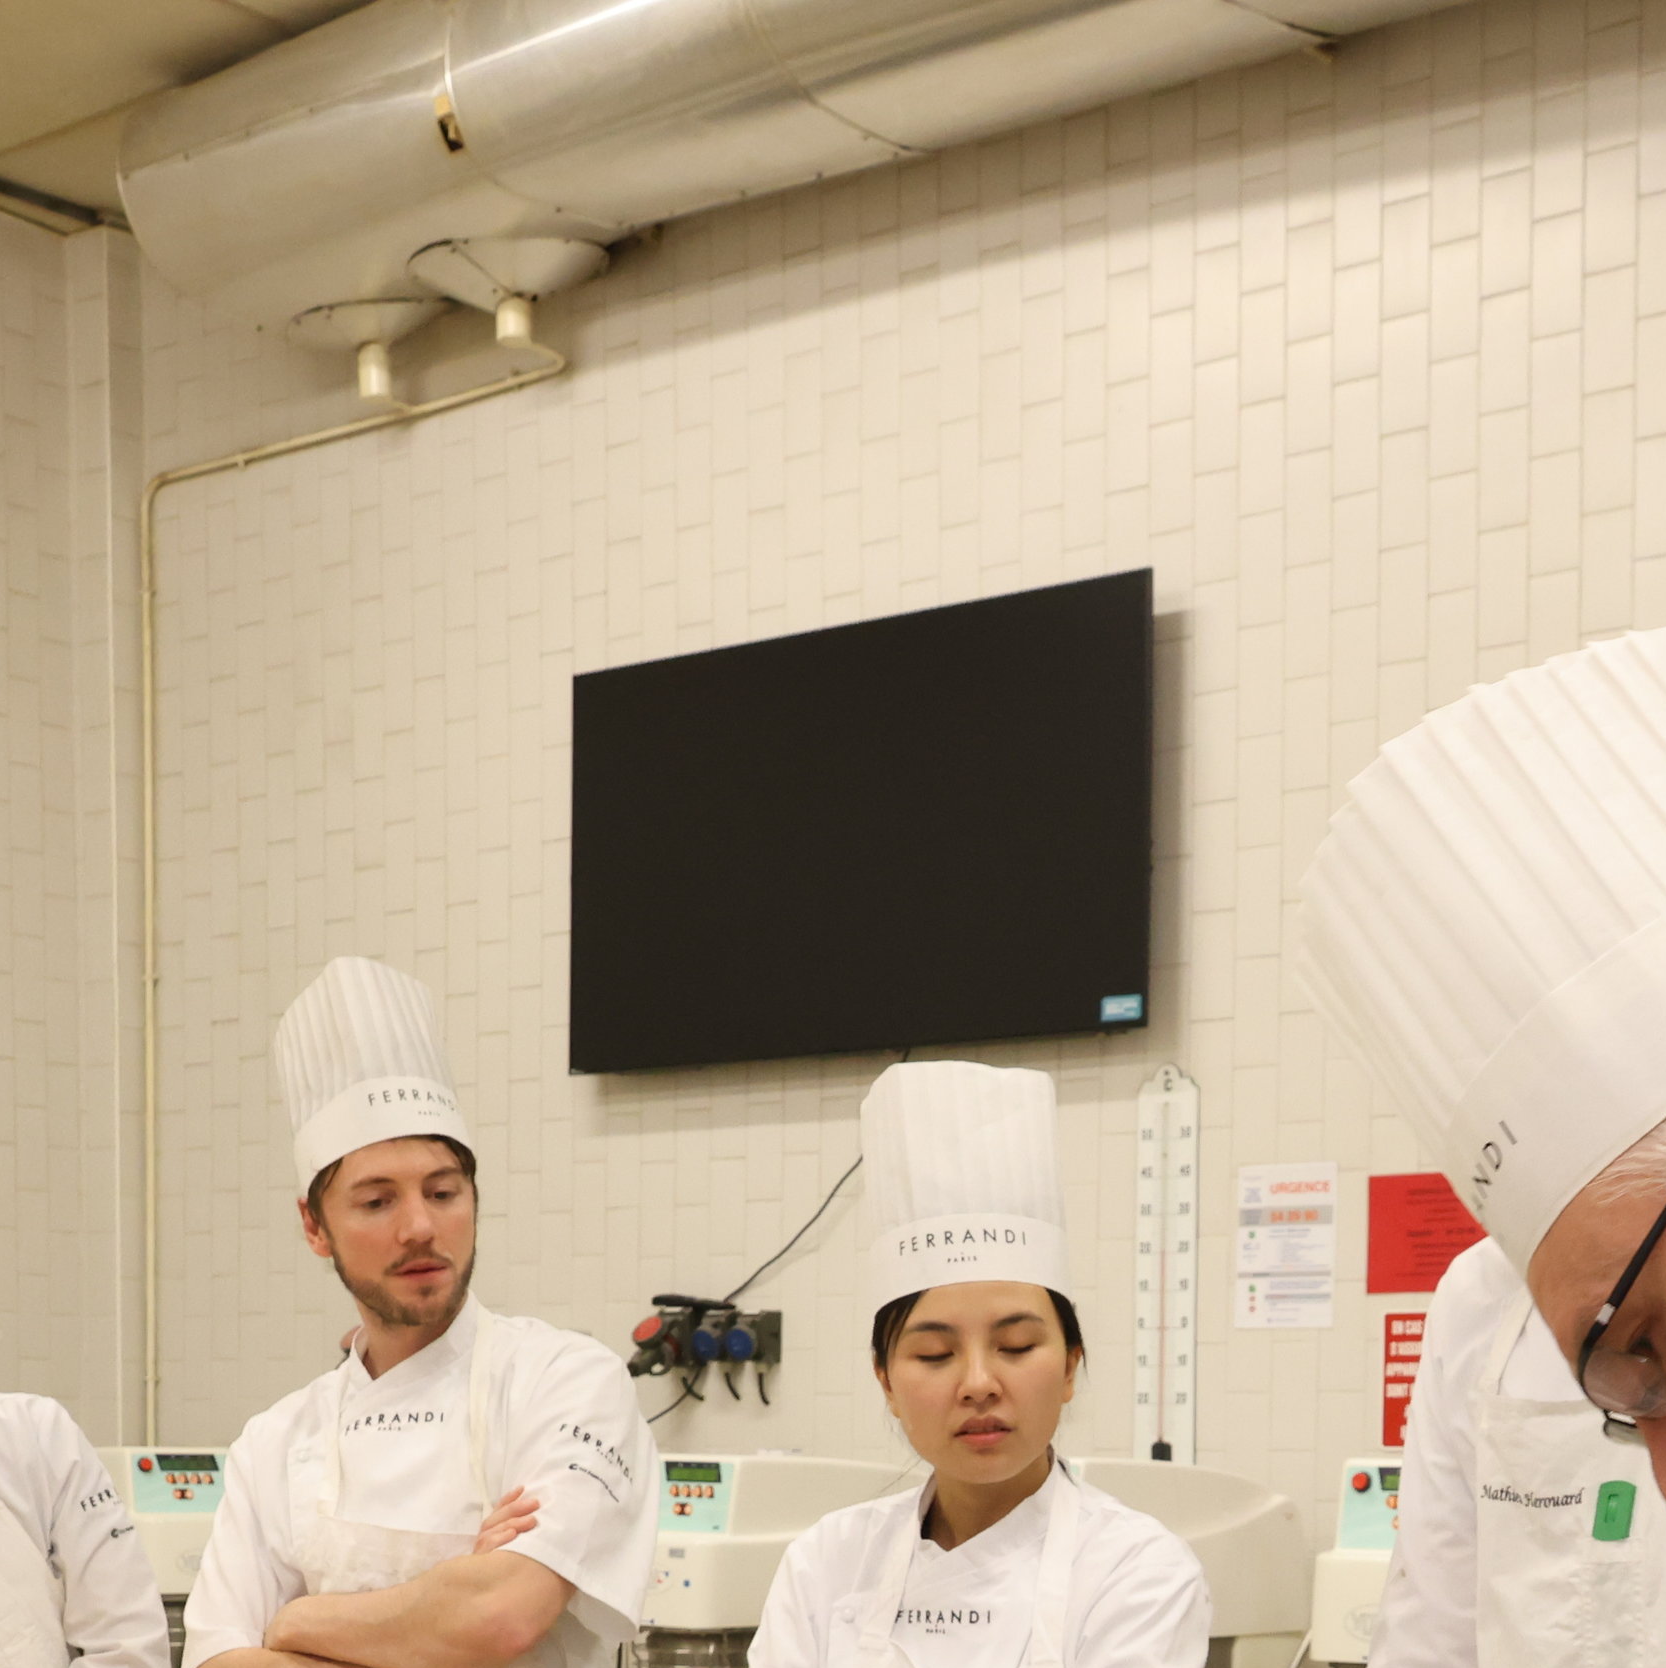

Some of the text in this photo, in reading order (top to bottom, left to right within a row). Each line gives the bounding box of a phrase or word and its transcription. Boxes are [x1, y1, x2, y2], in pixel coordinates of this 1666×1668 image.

[1269, 1180, 1331, 1195] URGENCE
[898, 1228, 1027, 1256] FERRANDI
[343, 1411, 445, 1437] FERRANDI
[893, 1609, 992, 1625] FERRANDI
